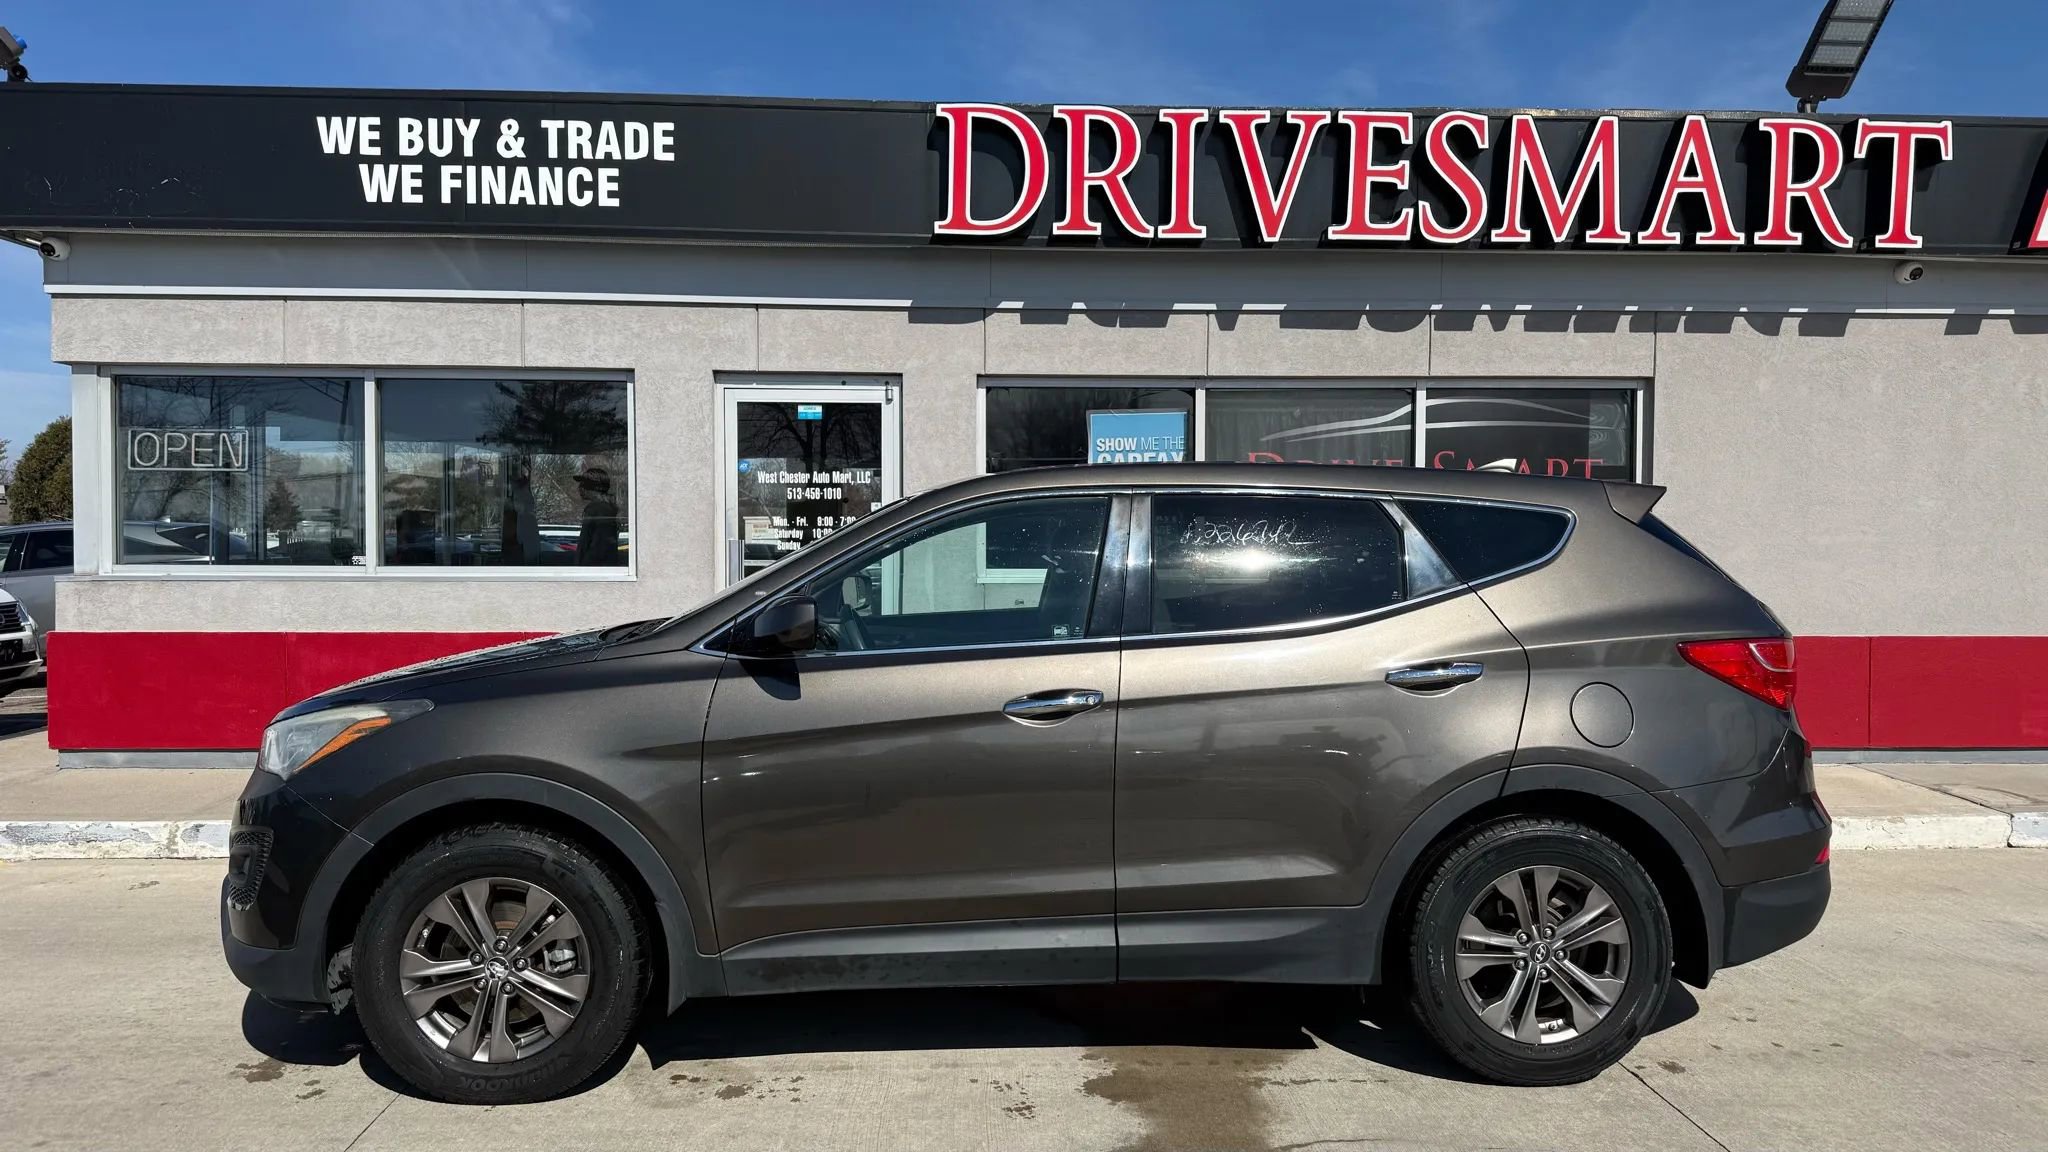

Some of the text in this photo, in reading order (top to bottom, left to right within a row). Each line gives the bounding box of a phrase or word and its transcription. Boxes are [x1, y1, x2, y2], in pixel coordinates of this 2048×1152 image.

[316, 116, 675, 161] WE BUY & TRADE
[934, 102, 1953, 249] DRIVESMART
[359, 163, 620, 207] WE FINANCE
[134, 432, 242, 467] OPEN
[1096, 435, 1185, 451] SHOW ME THE
[757, 471, 871, 485] West Chester Auto Mart, LLC
[772, 516, 790, 527] Mon.
[796, 516, 808, 527] Fri.
[774, 528, 803, 540] Saturday
[777, 540, 801, 550] Sunday
